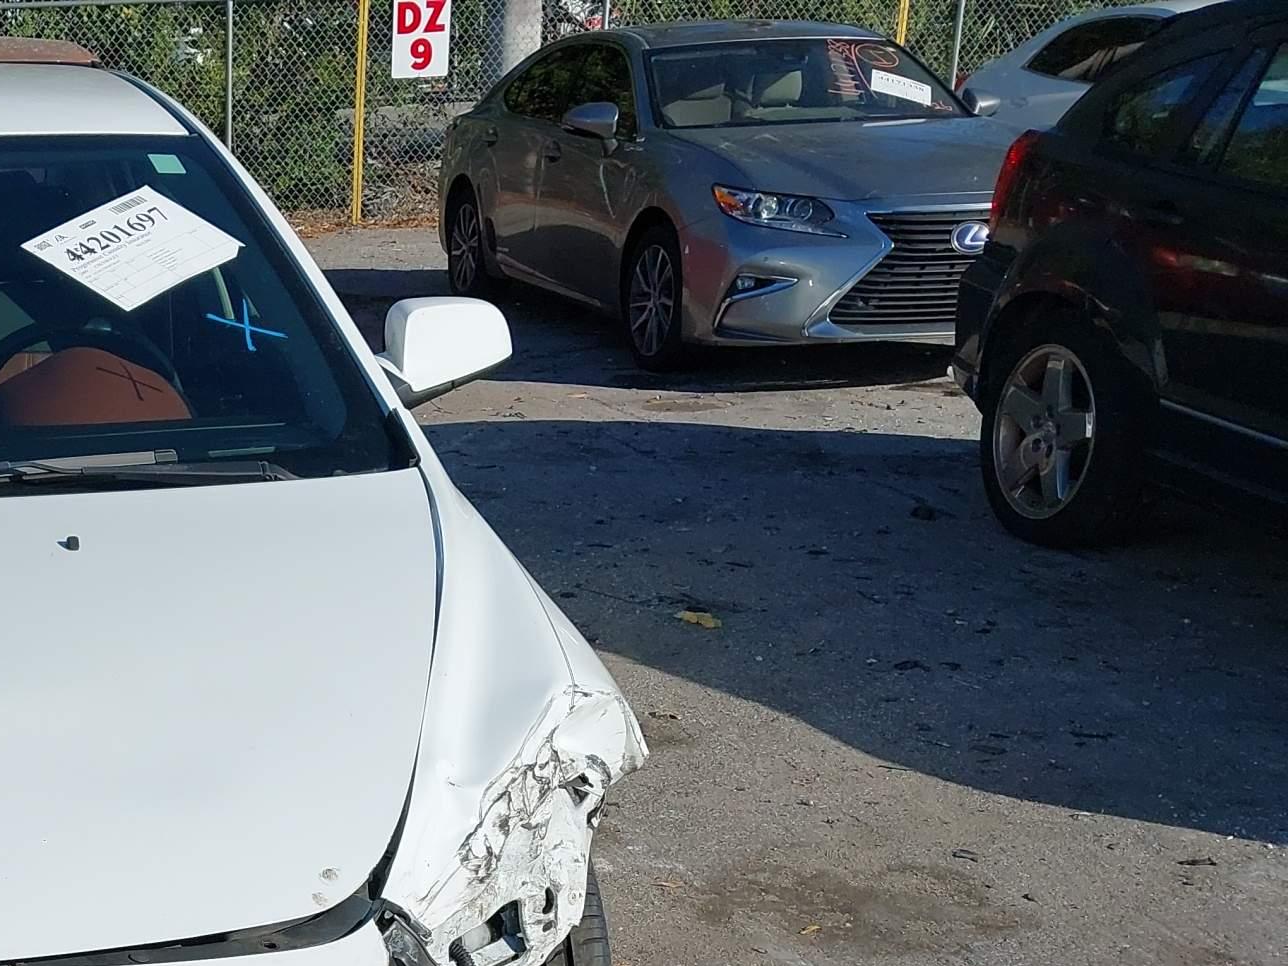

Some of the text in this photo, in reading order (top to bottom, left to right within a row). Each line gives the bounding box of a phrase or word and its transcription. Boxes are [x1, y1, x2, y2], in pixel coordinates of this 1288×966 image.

[397, 0, 446, 34] DZ
[410, 38, 432, 70] 9
[65, 206, 168, 261] 44201697
